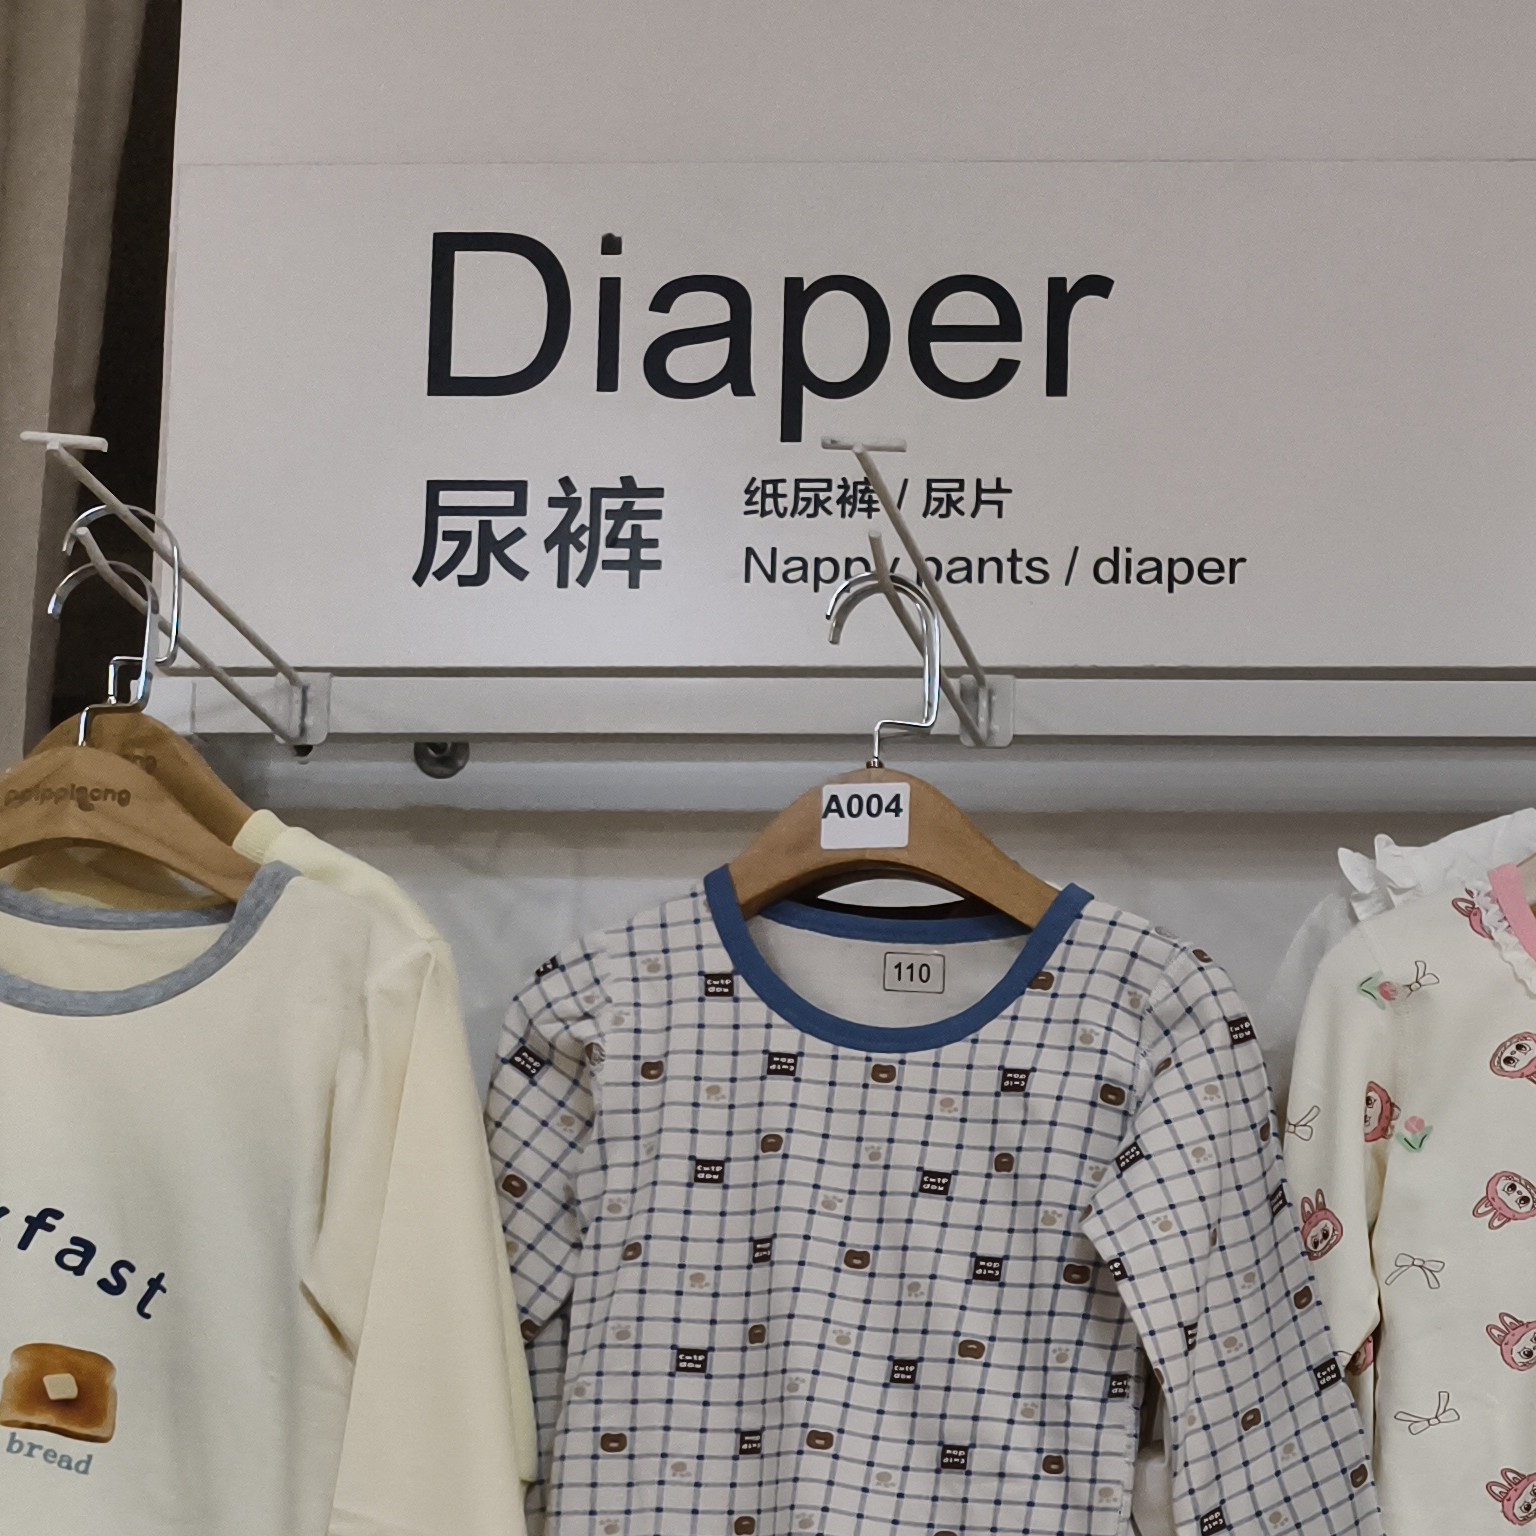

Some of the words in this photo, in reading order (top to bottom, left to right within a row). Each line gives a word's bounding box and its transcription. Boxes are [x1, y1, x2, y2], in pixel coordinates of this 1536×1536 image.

[427, 232, 1114, 443] Diaper
[743, 477, 881, 519] 纸尿裤
[922, 477, 1013, 519] 尿片
[413, 476, 664, 589] 尿裤
[744, 546, 900, 593] Napp
[916, 548, 1051, 585] pants
[1092, 546, 1246, 593] diaper
[821, 793, 903, 820] A004
[894, 961, 931, 984] 110
[6, 1432, 94, 1476] bread
